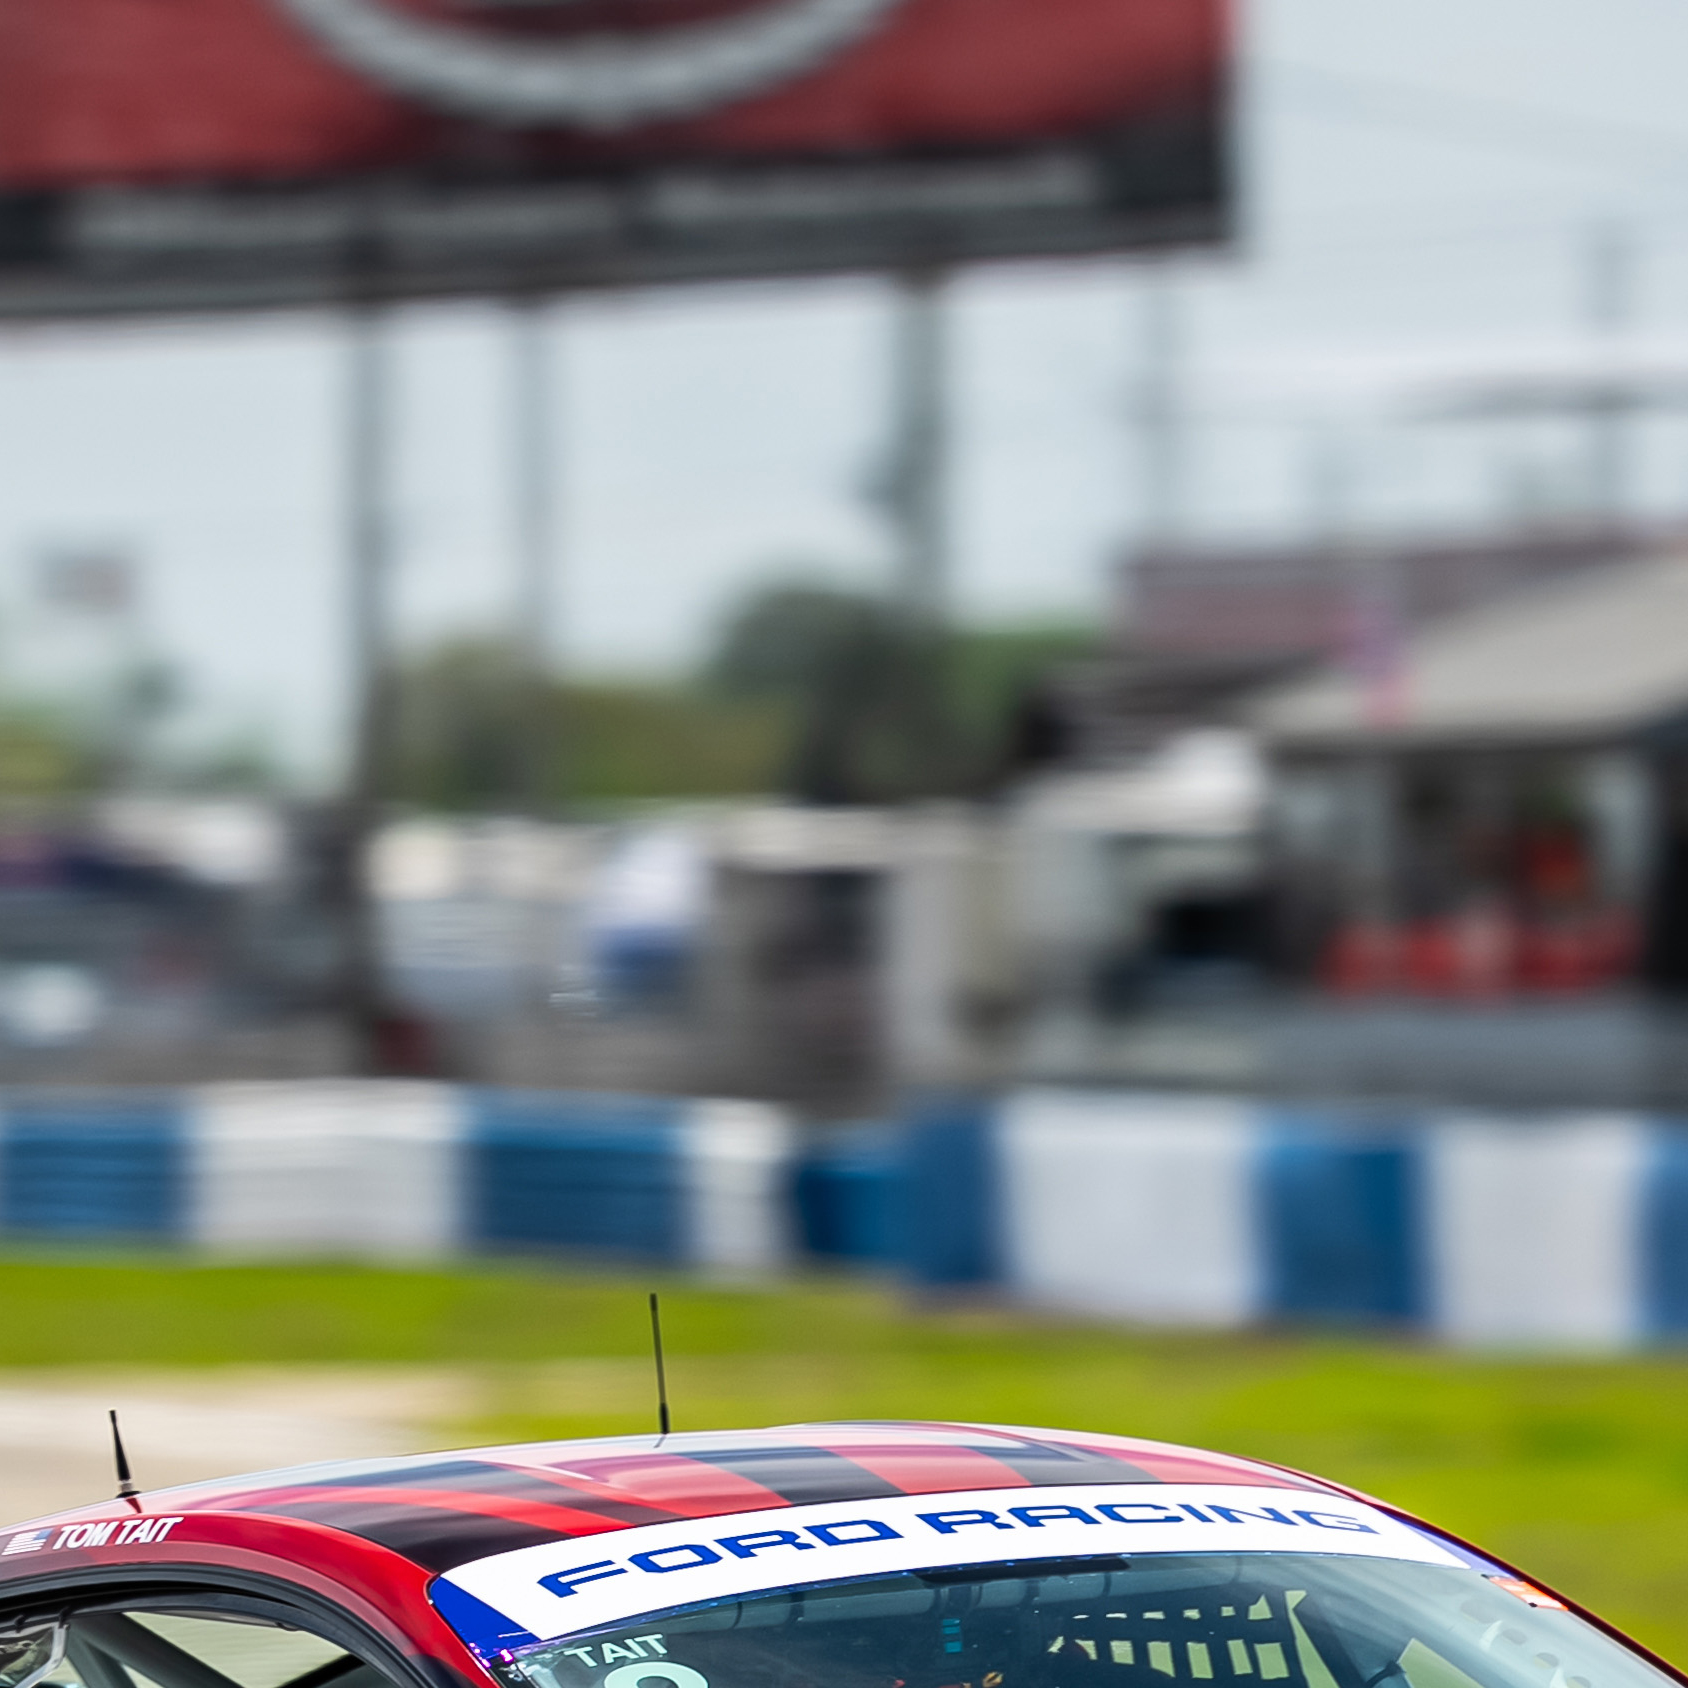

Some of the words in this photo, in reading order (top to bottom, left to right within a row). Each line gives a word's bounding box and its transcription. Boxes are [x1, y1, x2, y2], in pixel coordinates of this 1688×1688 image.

[52, 1521, 120, 1550] TOM
[115, 1516, 184, 1545] TAIT
[537, 1519, 904, 1598] FORD
[915, 1503, 1380, 1535] RACING
[564, 1634, 668, 1667] TAIT
